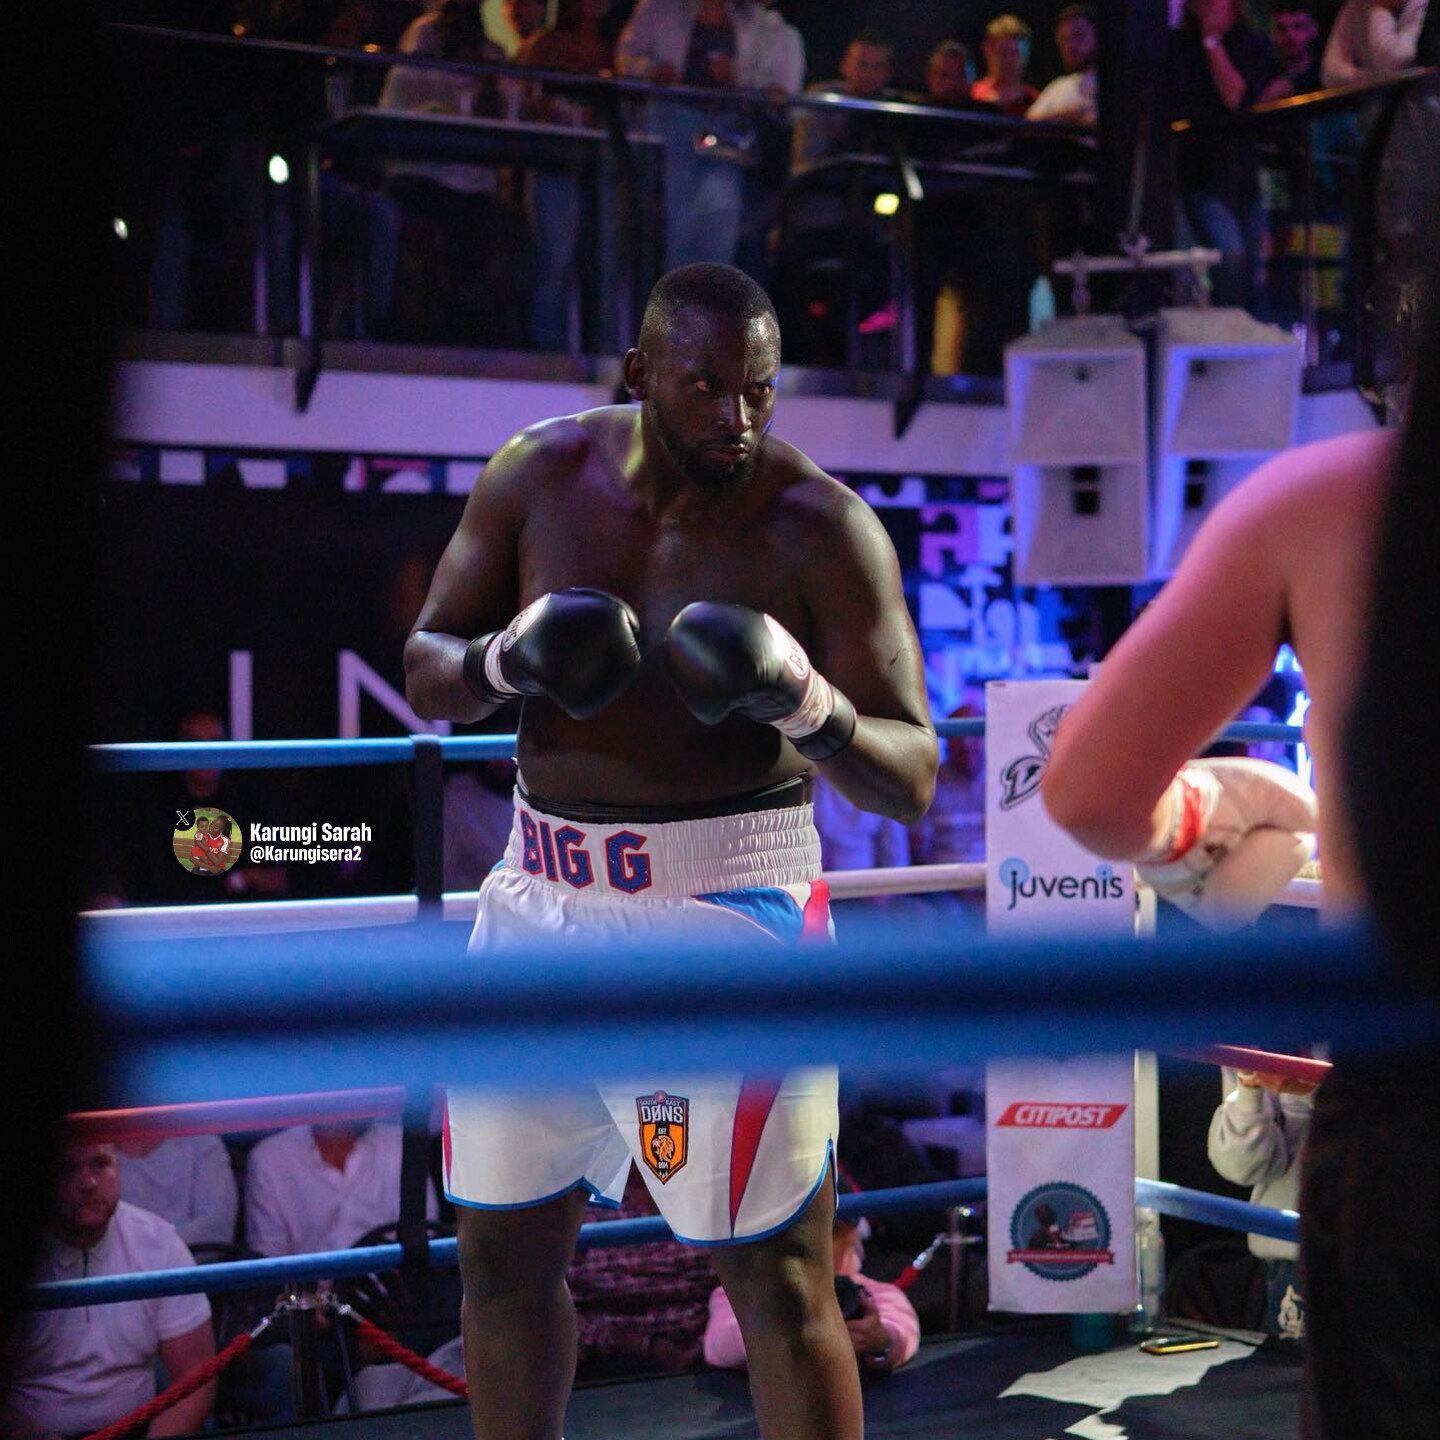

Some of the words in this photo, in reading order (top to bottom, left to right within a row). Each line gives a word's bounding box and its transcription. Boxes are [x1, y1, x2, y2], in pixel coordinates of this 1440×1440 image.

[520, 807, 595, 889] BIG
[604, 830, 652, 894] G
[1007, 869, 1123, 910] juvenis
[1014, 1104, 1110, 1125] CITIPOST
